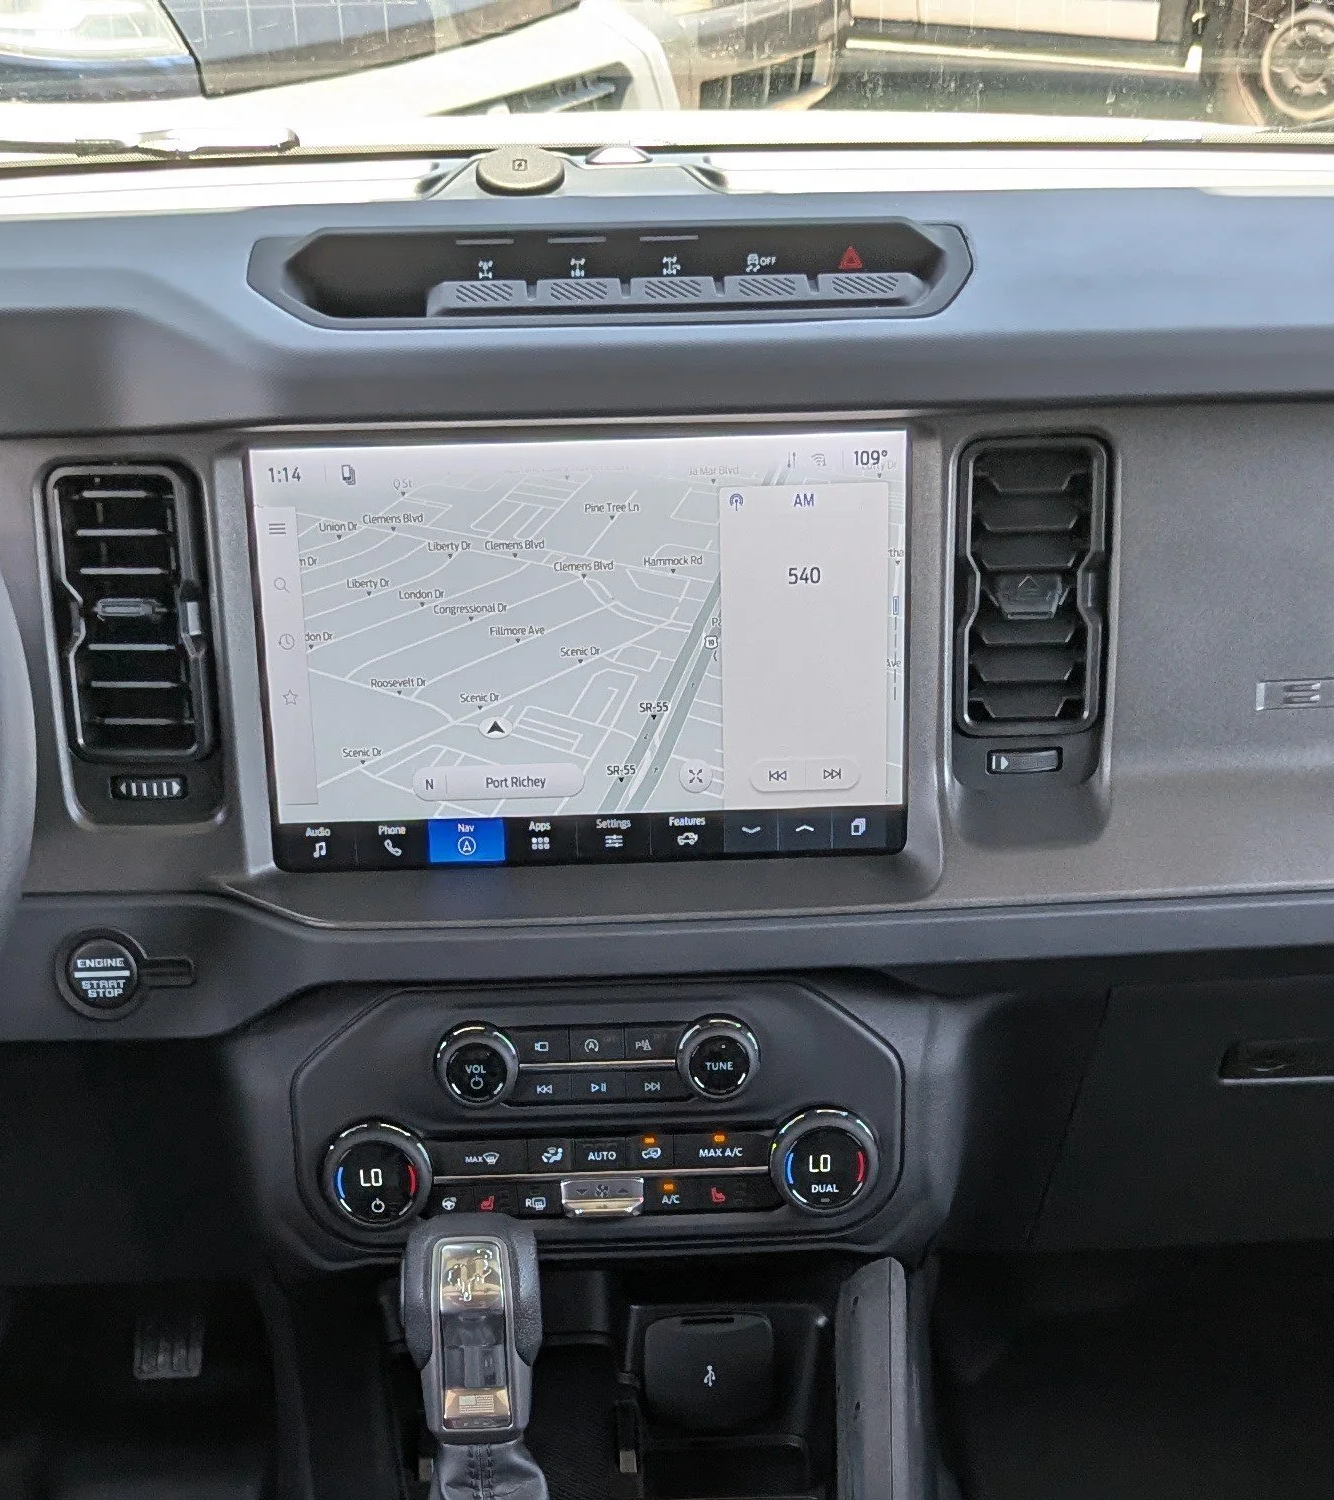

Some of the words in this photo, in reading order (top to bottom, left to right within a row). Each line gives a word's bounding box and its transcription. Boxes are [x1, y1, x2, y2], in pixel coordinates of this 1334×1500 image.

[760, 256, 777, 265] OFF
[854, 450, 888, 466] 109°
[268, 467, 301, 483] 1:14
[794, 494, 814, 507] AM
[584, 503, 605, 513] Pine
[606, 503, 627, 513] Tree
[629, 502, 639, 512] Ln
[363, 514, 401, 525] Clemens
[403, 513, 424, 523] Blvd
[319, 522, 345, 532] Union
[347, 521, 357, 531] Dr
[428, 541, 460, 552] Liberty
[461, 541, 471, 550] Dr
[485, 540, 523, 550] Clemens
[524, 539, 545, 549] Blvd
[554, 561, 592, 572] Clemens
[593, 560, 614, 570] Blvd
[643, 556, 688, 567] Hammock
[690, 555, 703, 565] Rd
[788, 566, 821, 585] 540
[347, 579, 378, 590] Liberty
[379, 578, 390, 587] Dr
[399, 590, 432, 600] London
[433, 589, 445, 599] Dr
[433, 603, 495, 615] Congressional
[497, 603, 507, 613] Dr
[323, 632, 333, 641] Dr
[490, 626, 526, 636] Fillmore
[528, 626, 545, 635] Ave
[560, 648, 589, 657] Scenic
[590, 647, 600, 656] Dr
[371, 678, 415, 688] Roosevelt
[416, 678, 426, 687] Dr
[460, 693, 487, 703] Scenic
[488, 692, 500, 702] Dr
[639, 702, 669, 713] SR-55
[342, 748, 370, 758] Scenic
[607, 764, 637, 776] SR-55
[426, 779, 434, 790] N
[485, 777, 509, 789] Port
[511, 776, 547, 789] Richey
[529, 821, 551, 832] Apps
[596, 818, 632, 830] Settings
[669, 816, 706, 827] Features
[305, 827, 331, 837] Audio
[379, 825, 406, 836] Phone
[458, 823, 475, 833] Nav
[77, 958, 125, 968] ENGINE
[81, 979, 126, 990] START
[87, 988, 123, 998] STOP
[465, 1065, 486, 1074] VOL
[704, 1061, 734, 1071] TUNE
[588, 1151, 617, 1161] AUTO
[699, 1148, 723, 1158] MAX
[724, 1147, 743, 1157] A/C
[809, 1154, 831, 1172] LO
[360, 1168, 383, 1187] LO
[811, 1184, 839, 1193] DUAL
[661, 1194, 680, 1204] A/C
